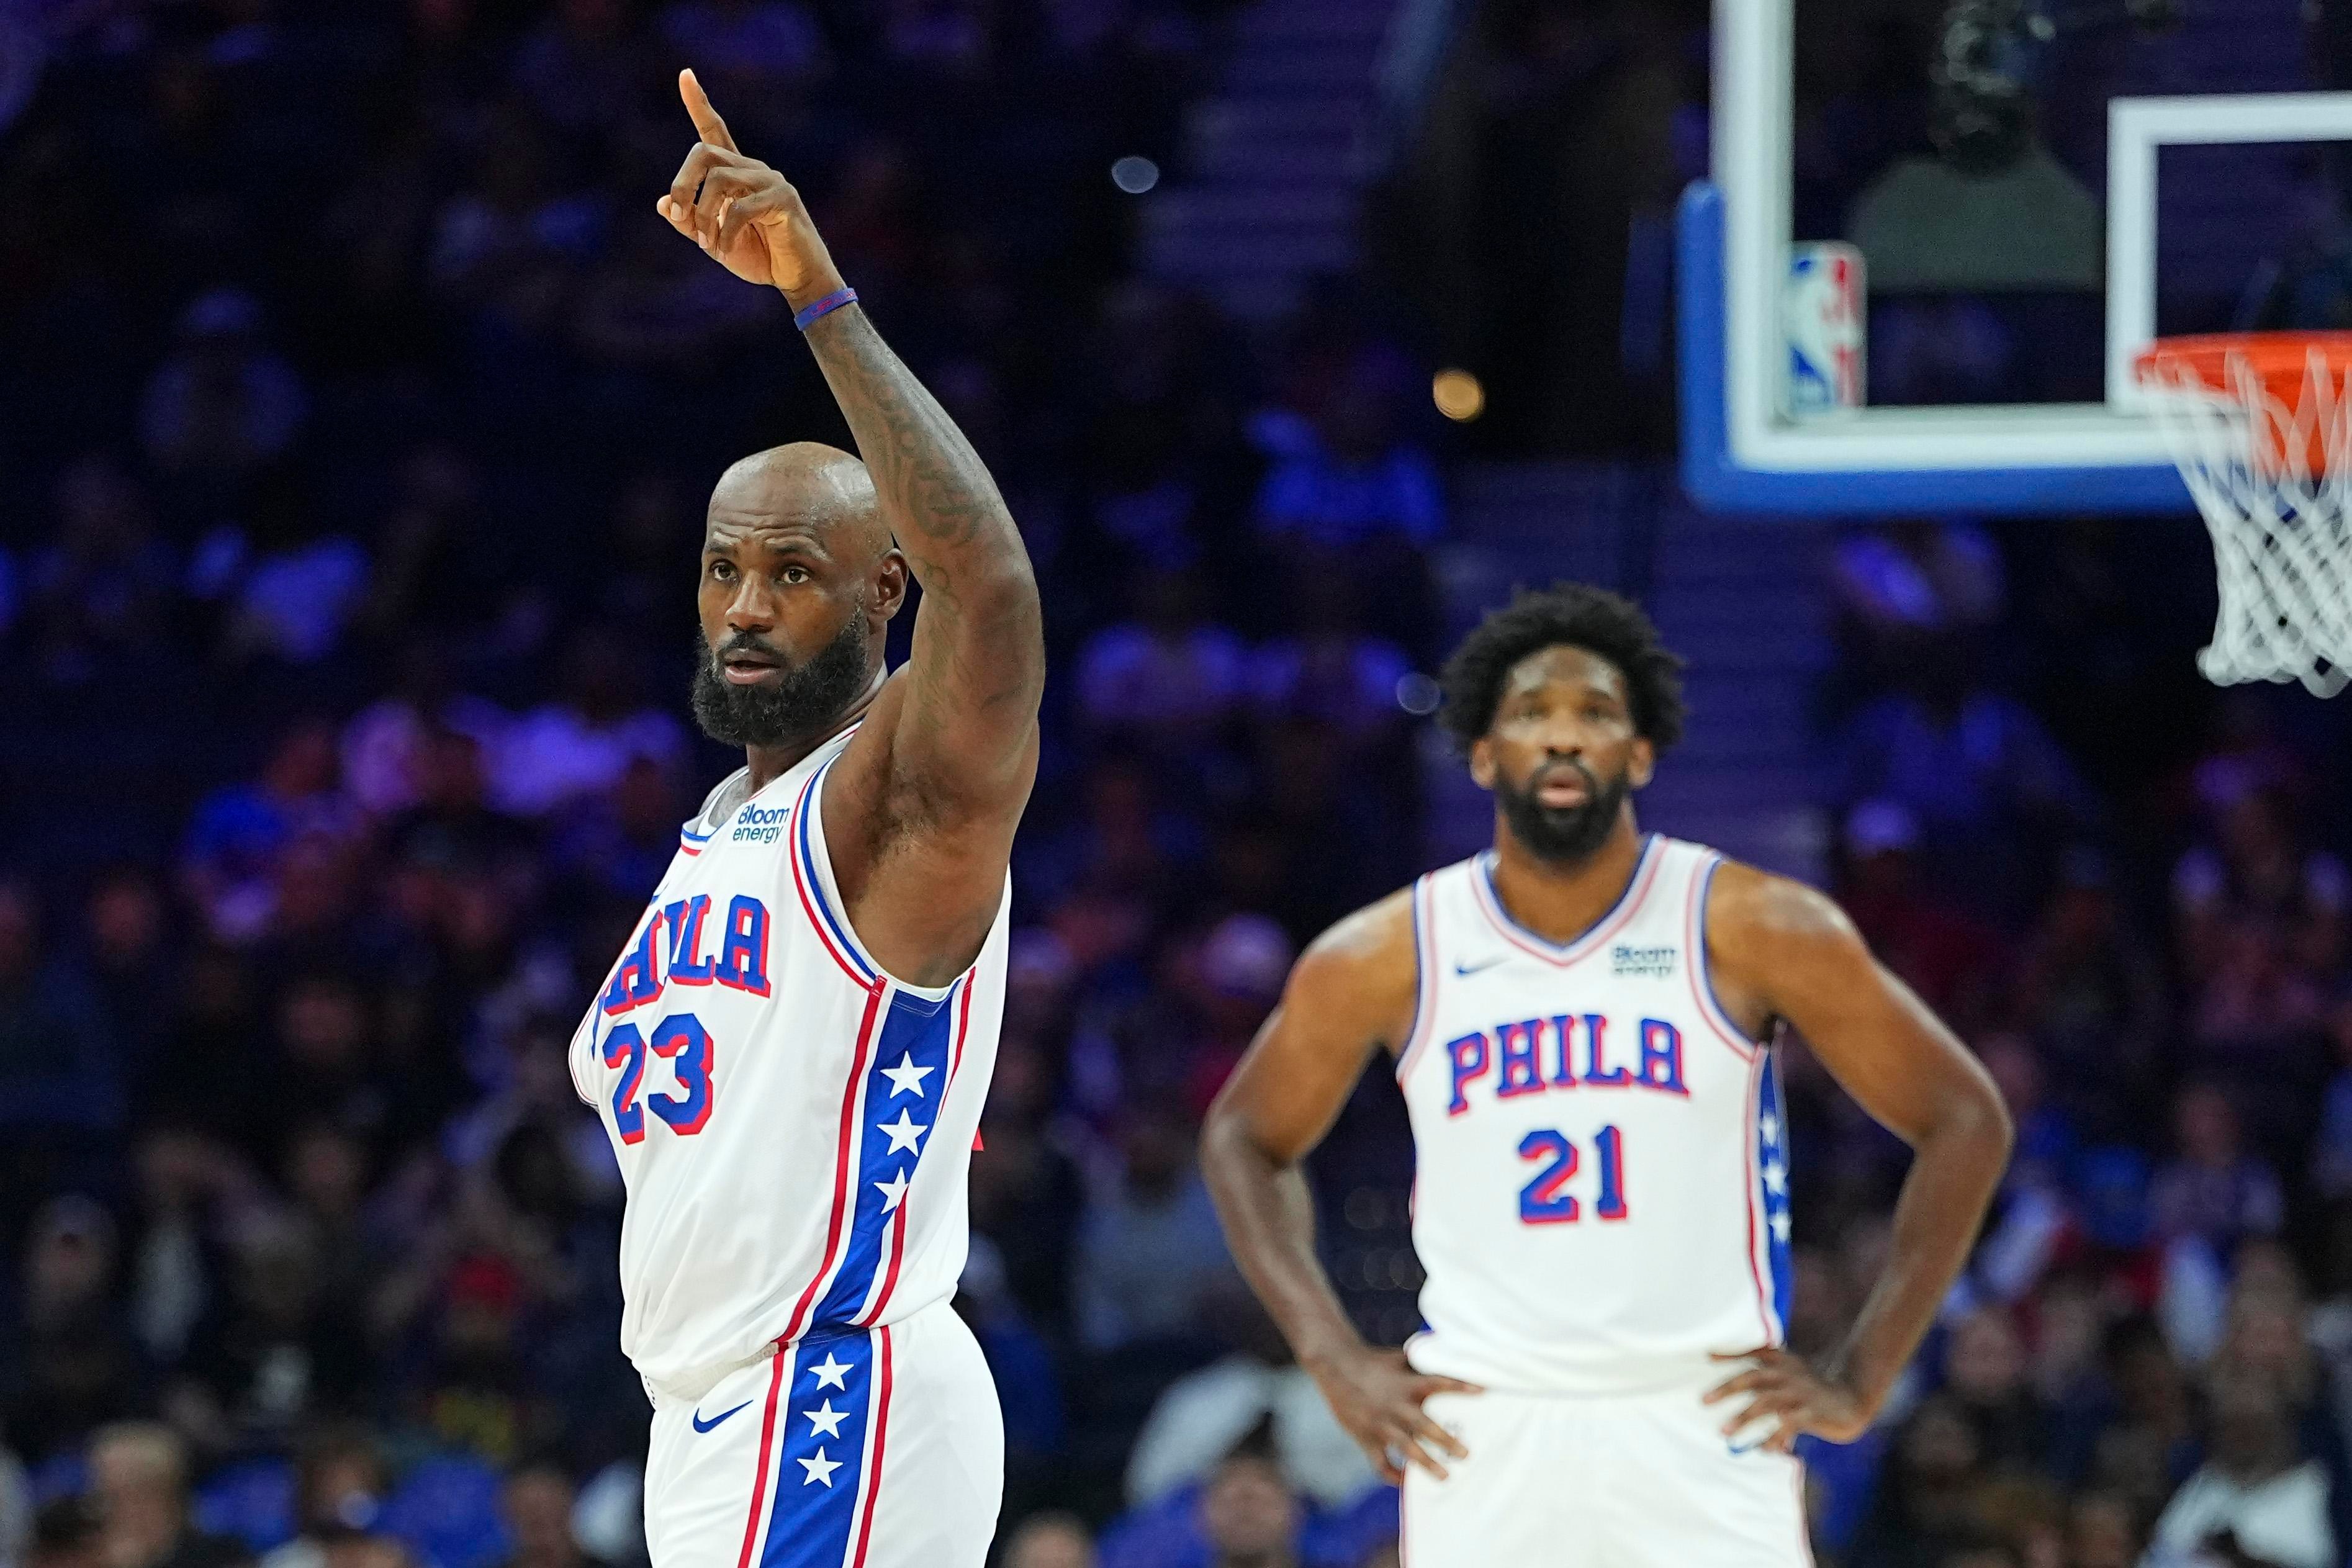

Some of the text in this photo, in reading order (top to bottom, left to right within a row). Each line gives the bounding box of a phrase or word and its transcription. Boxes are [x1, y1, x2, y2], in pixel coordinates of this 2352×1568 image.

[733, 825, 783, 844] energy
[738, 803, 790, 824] Bloom
[593, 894, 770, 1019] HILA
[602, 1013, 713, 1145] 23
[1446, 1014, 1689, 1117] PHILA
[1518, 1125, 1626, 1224] 21
